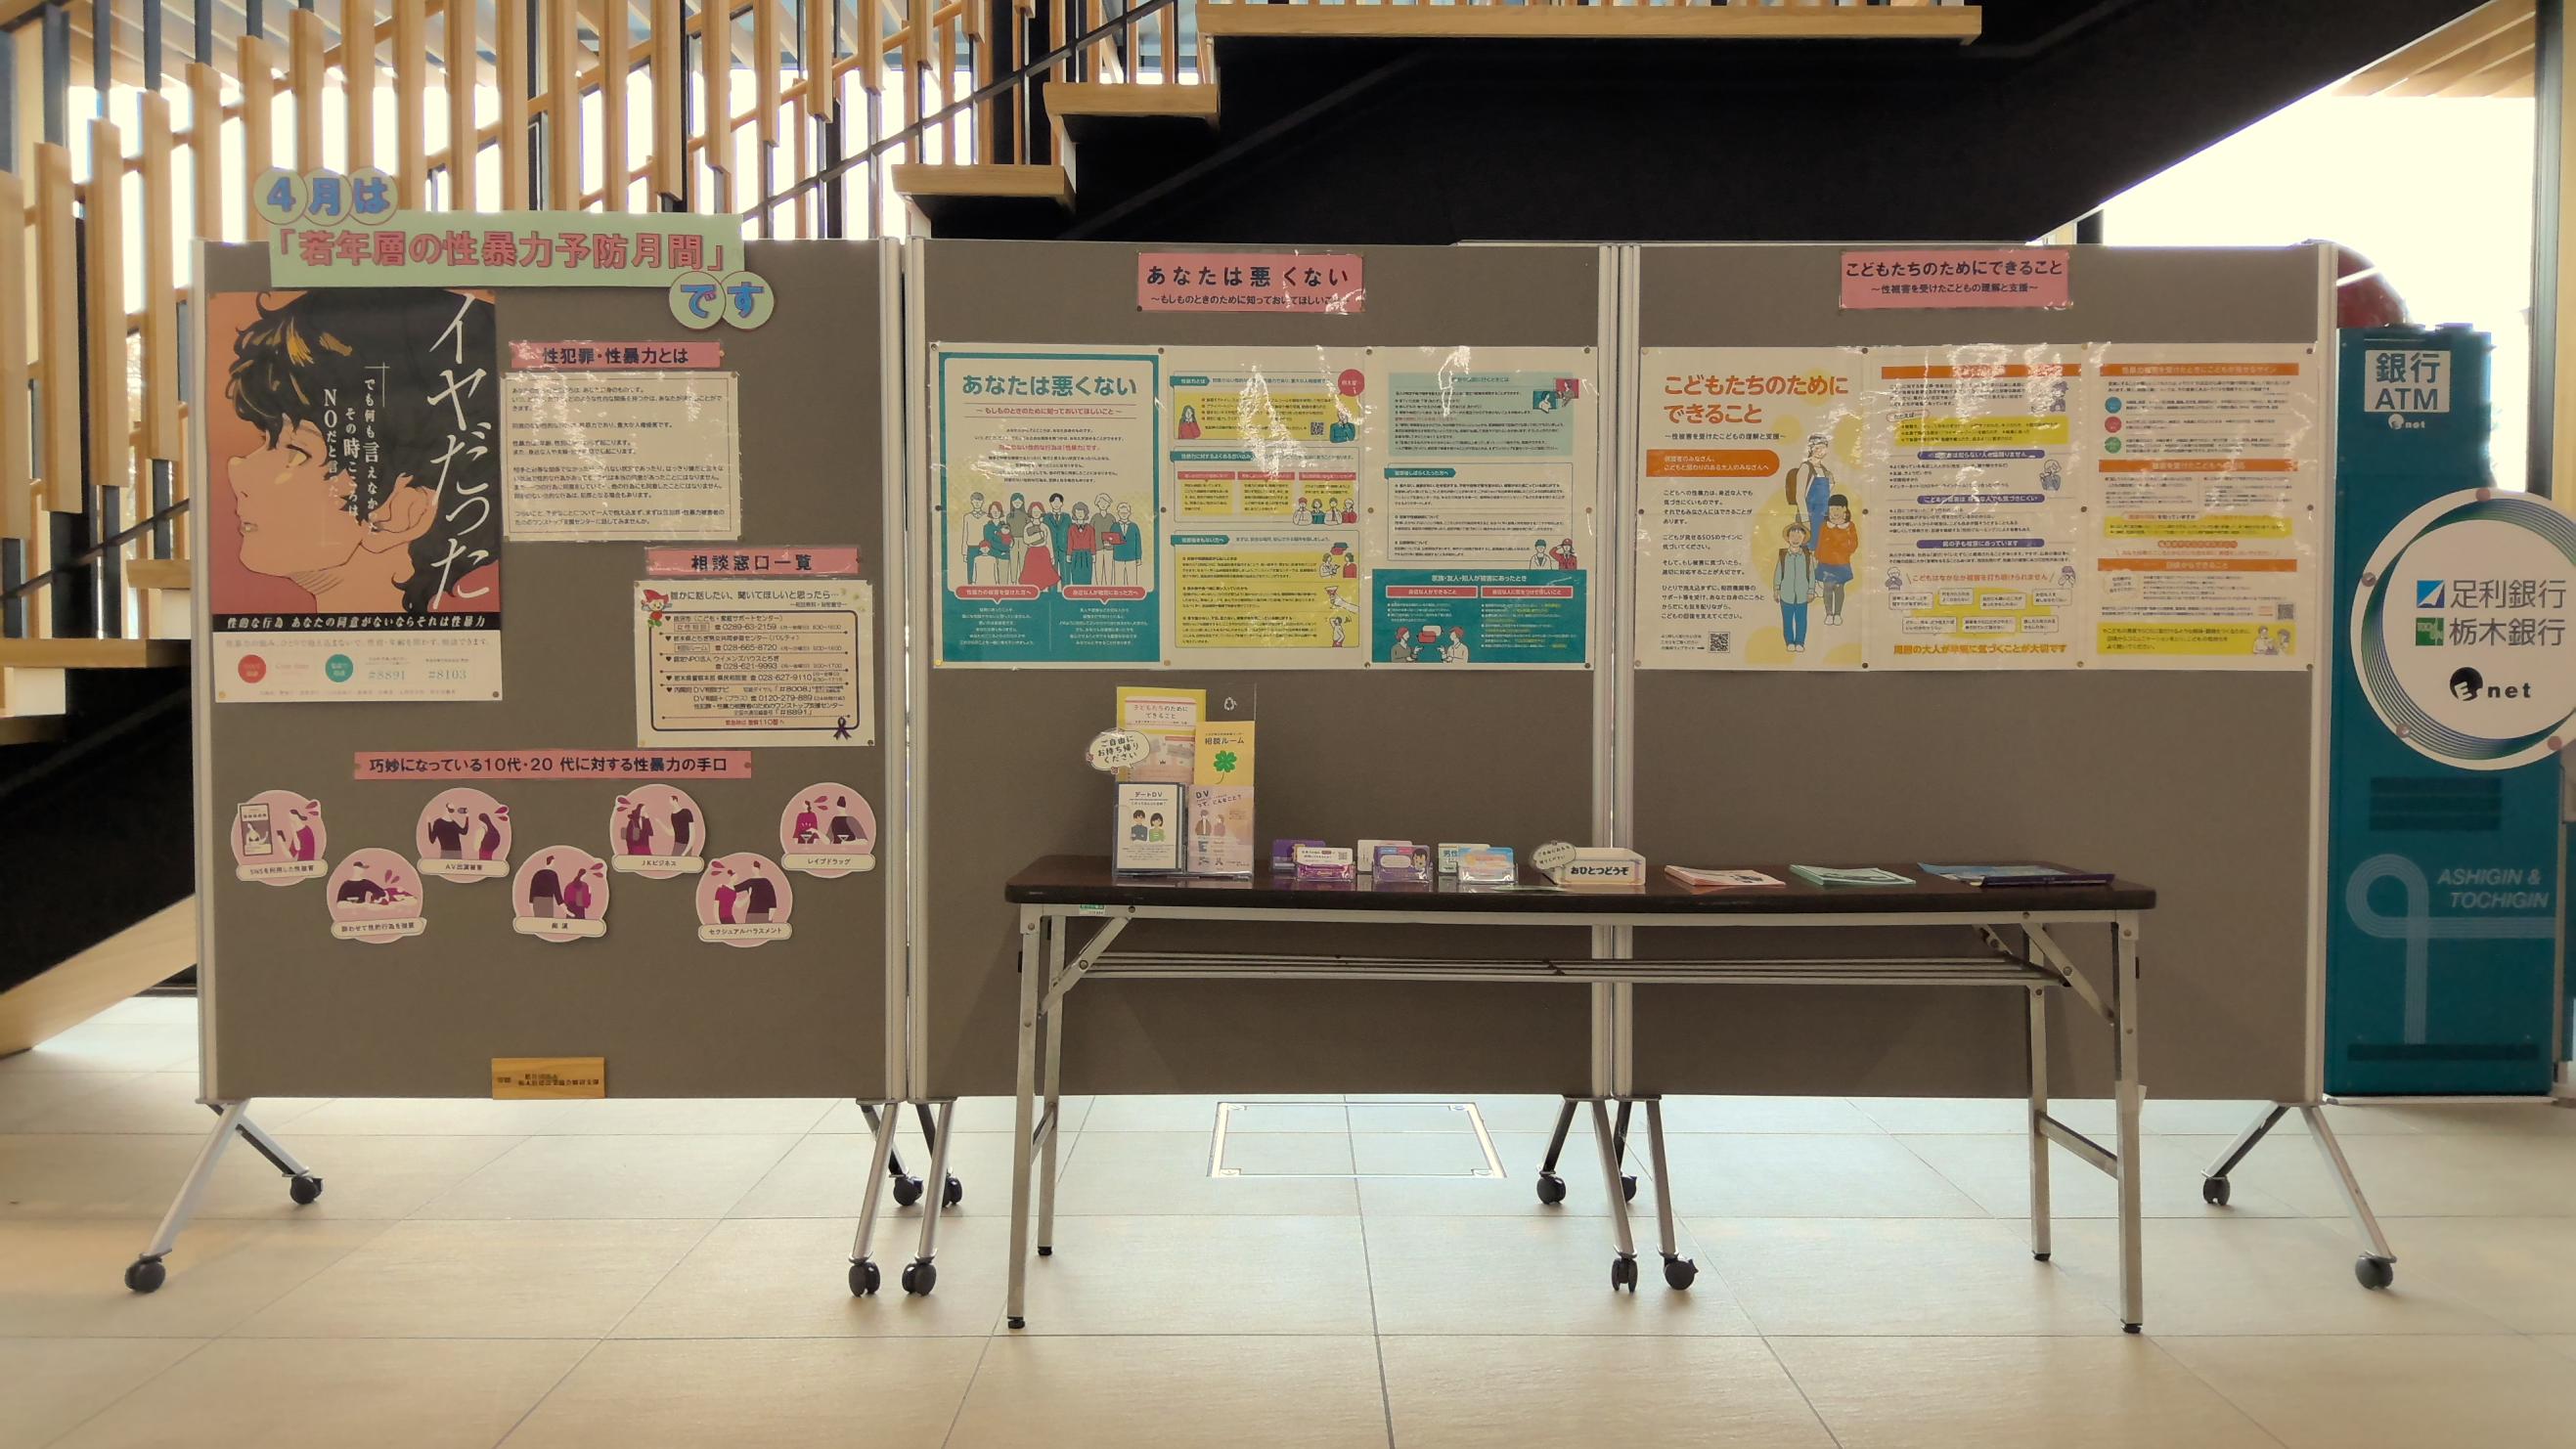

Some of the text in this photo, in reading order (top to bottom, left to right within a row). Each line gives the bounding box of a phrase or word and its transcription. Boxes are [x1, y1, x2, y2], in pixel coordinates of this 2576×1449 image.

[266, 176, 390, 217] 4月は
[281, 230, 724, 272] 「若年層の性暴力予防月間」
[1146, 265, 1349, 287] あなたは悪くない
[1846, 260, 2064, 278] こどもたちのためにできること
[680, 281, 763, 320] です
[542, 347, 688, 365] 性犯罪・性暴力とは
[2376, 353, 2440, 383] 銀行
[962, 375, 1137, 397] あなたは悪くない
[1665, 373, 1849, 396] こどもたちのために
[2376, 387, 2438, 411] ATM
[1664, 403, 1762, 424] できること
[426, 293, 492, 610] イヤだった
[691, 553, 813, 571] 相談窓口一覧
[2450, 579, 2566, 608] 足利銀行
[2449, 618, 2566, 646] 栃木銀行
[1097, 742, 1139, 758] お持ち帰り
[1100, 734, 1134, 748] ご自由に
[1103, 752, 1137, 764] ください
[1196, 790, 1210, 799] DV
[1571, 866, 1629, 875] おひとつどうぞ
[2438, 868, 2541, 885] ASHIGIN &
[2450, 892, 2549, 908] TOCHIGIN
